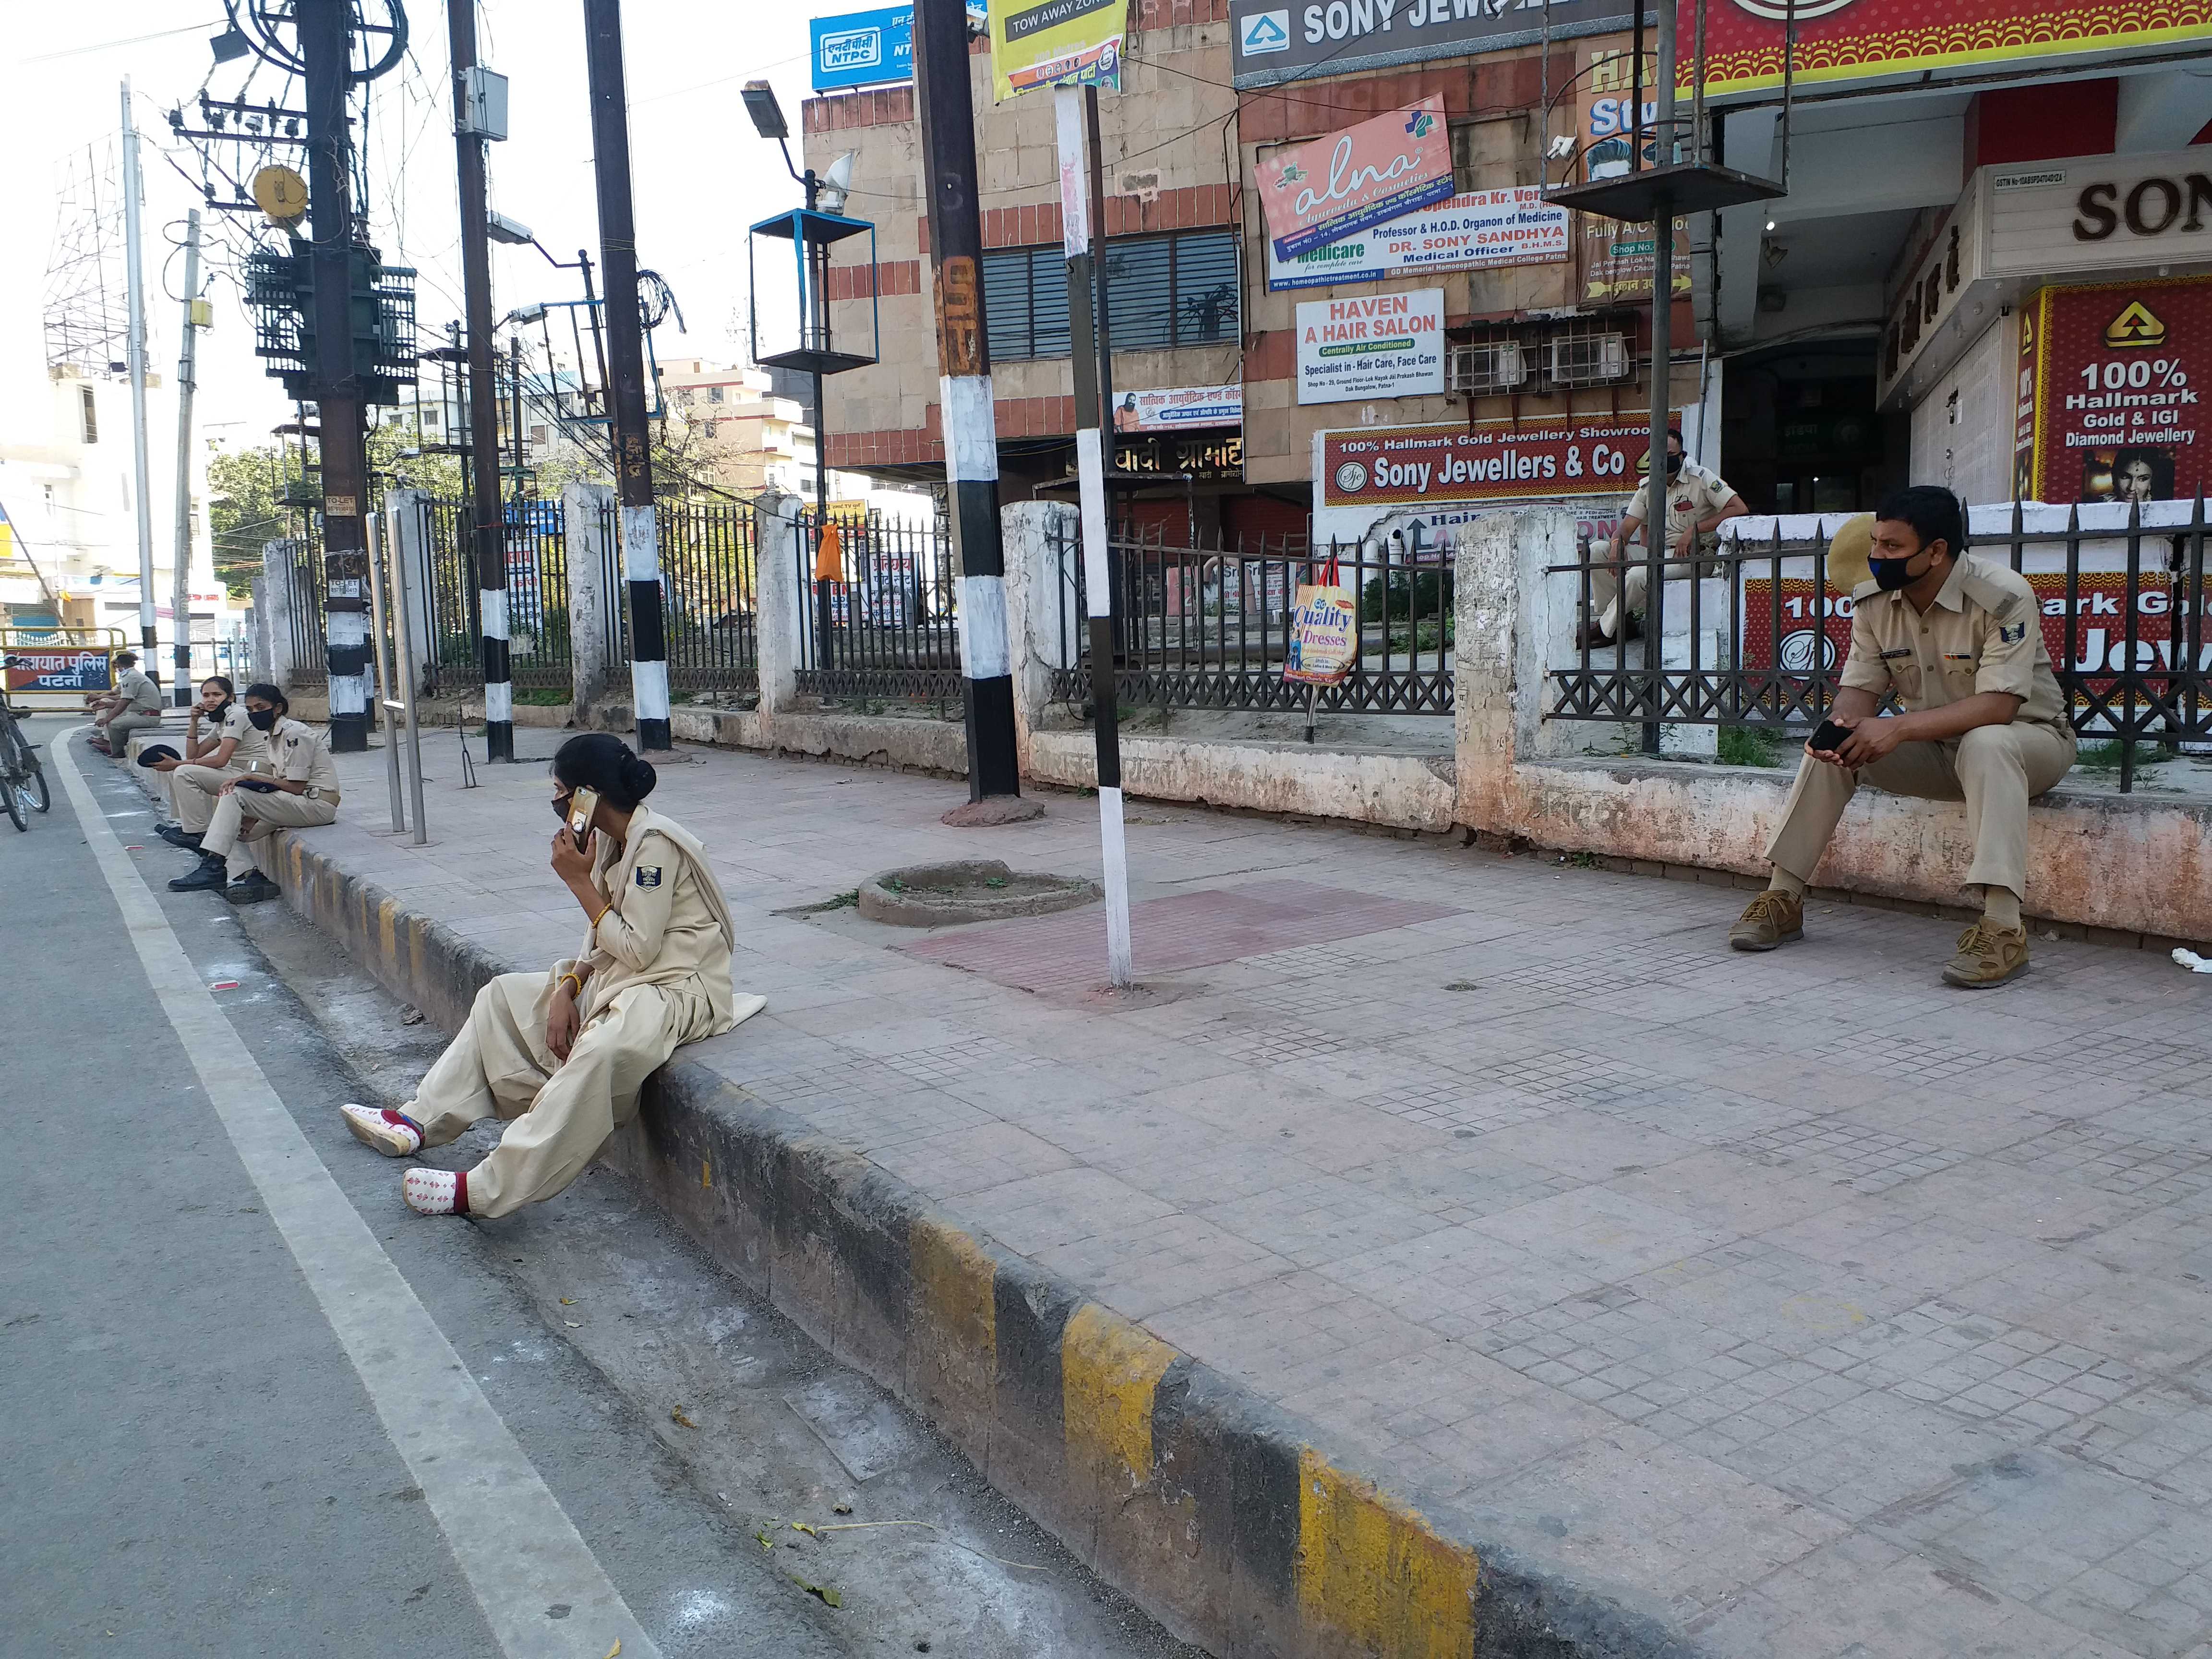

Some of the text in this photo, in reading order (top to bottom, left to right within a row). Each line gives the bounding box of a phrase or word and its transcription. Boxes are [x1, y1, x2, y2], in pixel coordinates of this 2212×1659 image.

[1012, 0, 1104, 33] TOW AWAY ZON
[828, 36, 873, 53] एनटीपीसी
[831, 51, 870, 64] NTPC
[1295, 135, 1421, 215] alna
[1373, 172, 1428, 196] Cosmetics
[1996, 178, 2010, 187] GSTIN
[1491, 192, 1510, 204] Kr.
[1348, 201, 1383, 219] आयुर्वेदिक
[1373, 210, 1563, 240] Professor & H.O.D. Organon of Medicine
[1587, 224, 1619, 239] Fully
[1389, 226, 1564, 254] DR. SONY SANDHYA
[1521, 240, 1565, 250] B.H.M.S.
[1613, 245, 1635, 254] Shop
[1403, 245, 1515, 264] Medical Officer
[1305, 264, 1314, 273] for
[1317, 261, 1346, 270] complete
[1402, 265, 1434, 275] Memorial
[1436, 261, 1486, 273] Homoeopathic
[1488, 257, 1515, 265] Medical
[1516, 254, 1544, 265] College
[1330, 296, 1407, 321] HAVEN
[1305, 314, 1435, 344] A HAIR SALON
[1322, 346, 1354, 355] Centrally
[1368, 339, 1411, 350] Conditioned
[1305, 354, 1436, 377] Specialist in Hair Care, Face Care
[2081, 358, 2187, 390] 100%
[1169, 390, 1204, 406] आयुर्वेदिक
[2066, 389, 2199, 409] Hallmark
[2083, 410, 2178, 428] Gold & IGI
[1340, 427, 1650, 453] 100% Hallmark Gold Jewellery Showroo
[2066, 428, 2196, 447] Diamond Jewellery
[1374, 444, 1625, 493] Sony Jewellers & Co
[1294, 605, 1352, 633] Quality
[1303, 630, 1346, 646] Dresses
[69, 651, 108, 674] पुलिस
[37, 674, 84, 687] पटना
